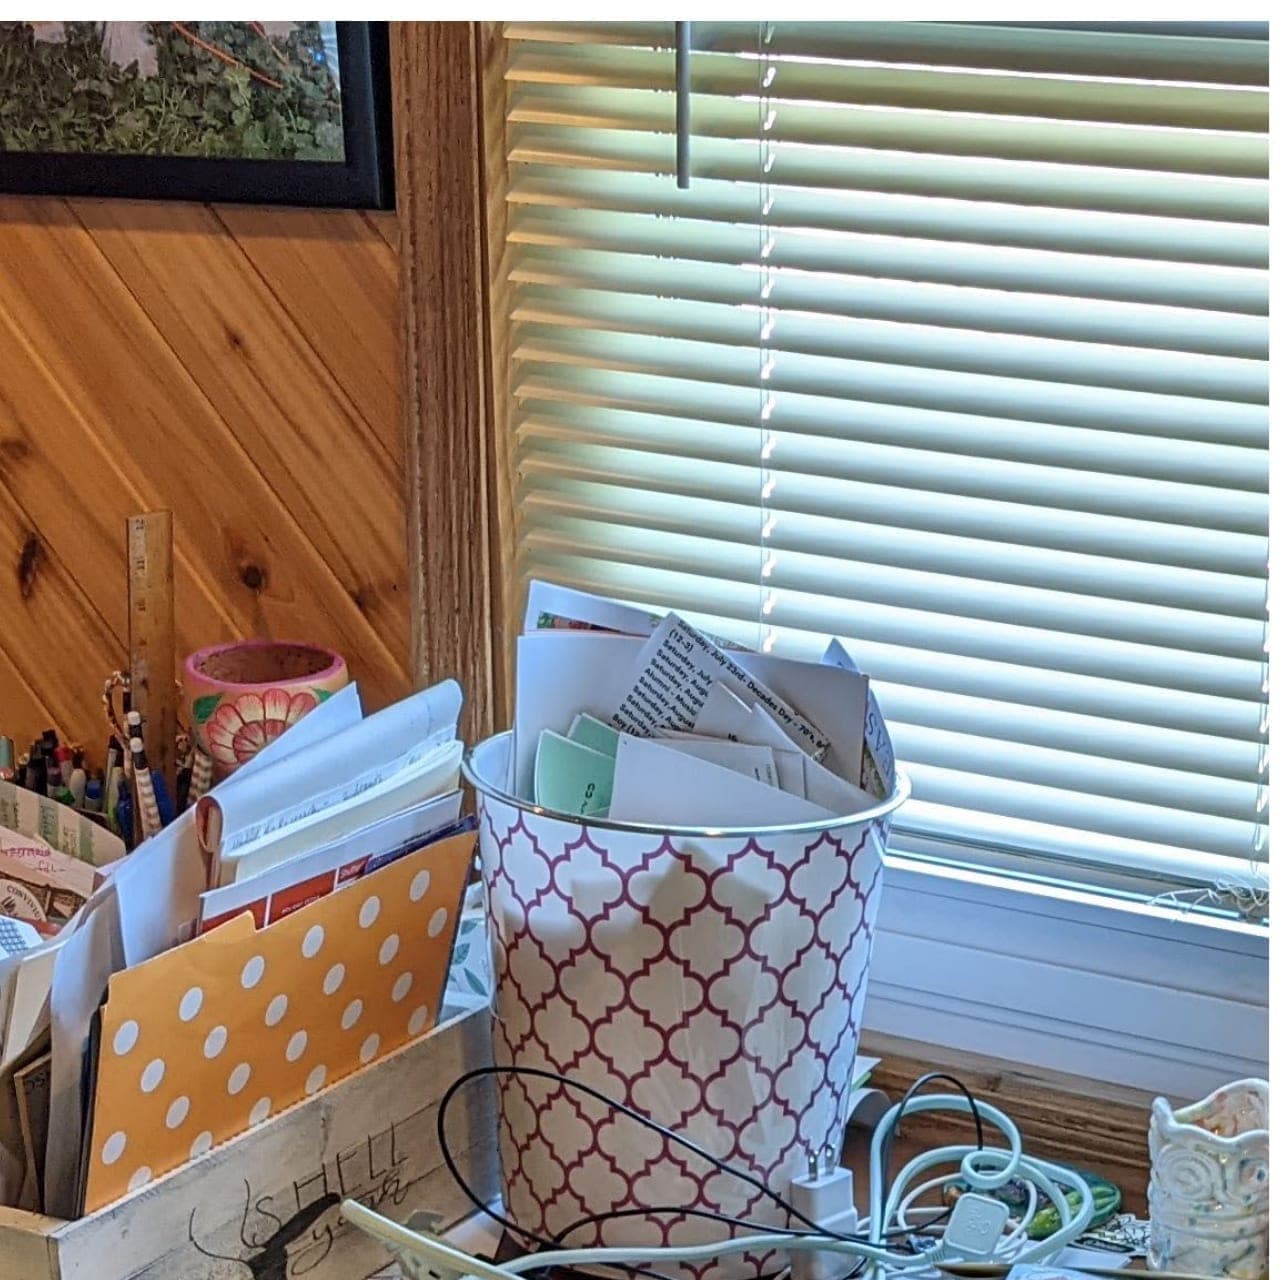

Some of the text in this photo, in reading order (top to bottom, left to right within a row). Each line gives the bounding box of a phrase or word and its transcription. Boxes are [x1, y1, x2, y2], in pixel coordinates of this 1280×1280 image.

[650, 658, 683, 691] Saturday,
[656, 648, 690, 682] Saturday,
[662, 639, 713, 686] Saturday, July
[644, 668, 670, 692] Alumni
[710, 649, 727, 667] July
[747, 681, 778, 711] Decades
[778, 706, 794, 724] Day
[633, 685, 664, 718] Saturday,
